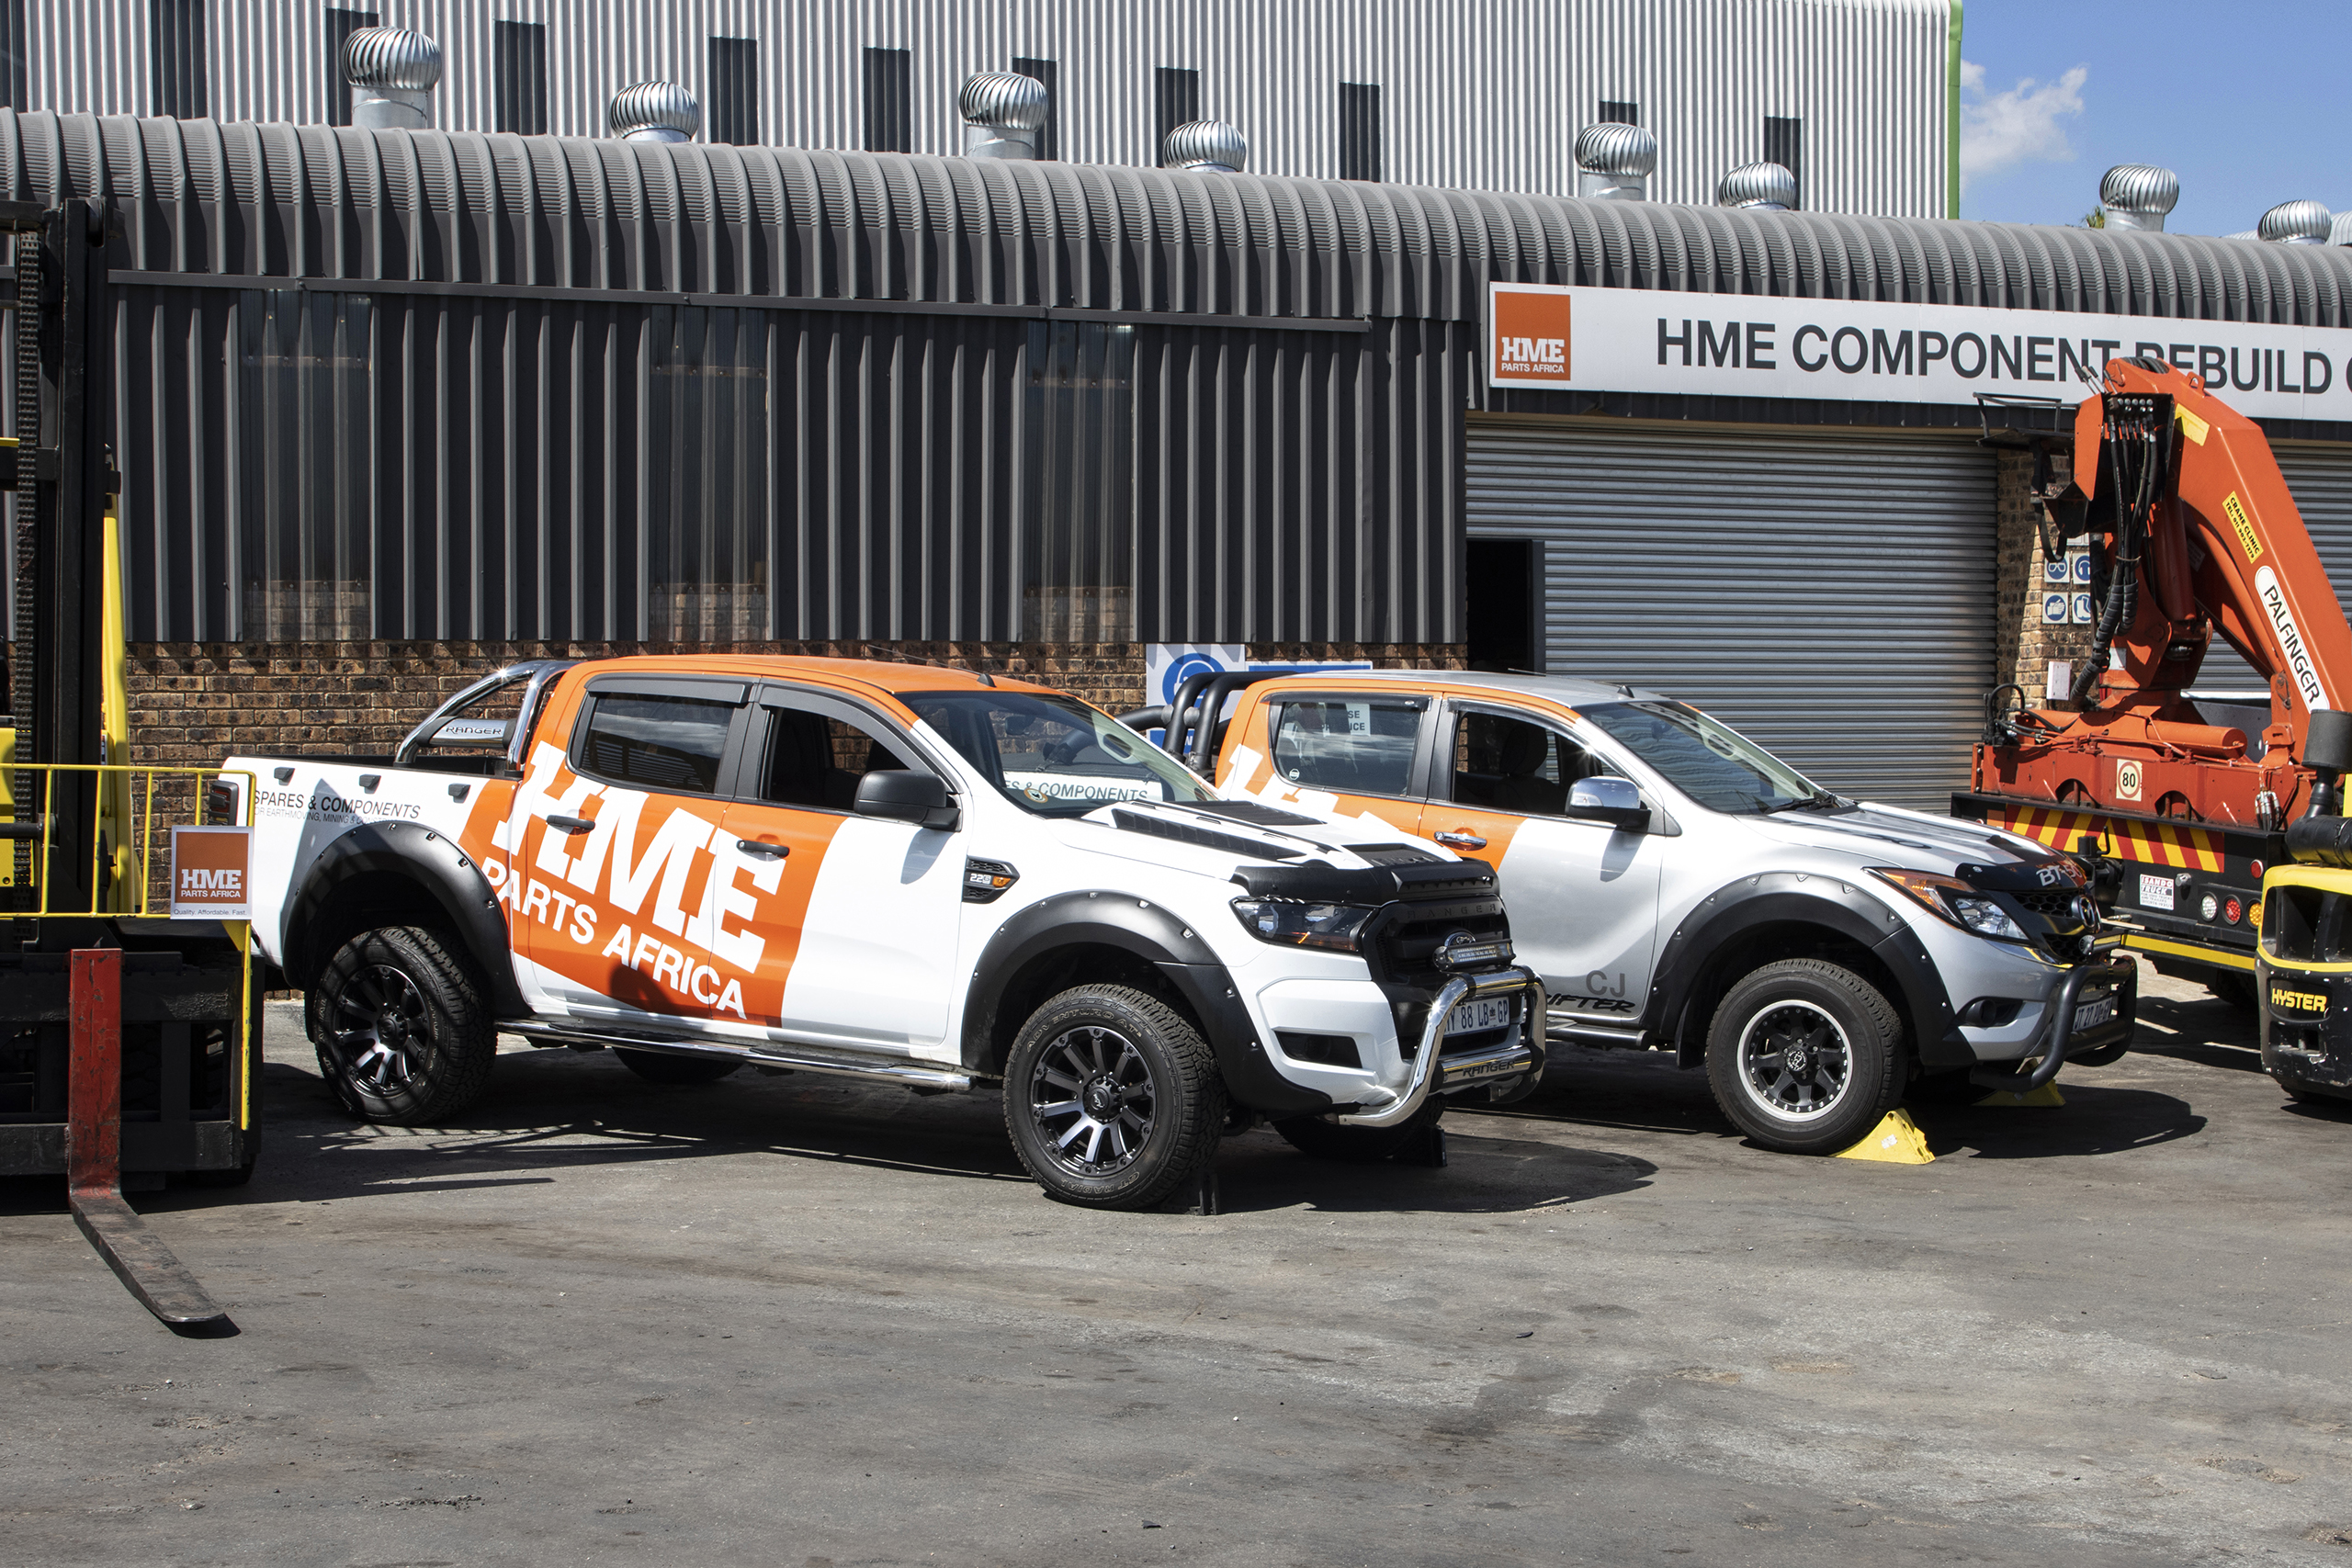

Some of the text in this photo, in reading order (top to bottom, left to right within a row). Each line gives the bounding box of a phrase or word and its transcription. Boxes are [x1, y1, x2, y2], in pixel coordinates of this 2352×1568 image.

[1501, 336, 1565, 363] HME
[1657, 318, 1776, 369] HME
[1792, 323, 2120, 385] COMPONENT
[1501, 362, 1565, 374] PARTS AFRICA
[2230, 497, 2260, 554] CRANE CLINIC
[2264, 585, 2320, 704] PALFINGER
[446, 726, 502, 735] RANGER
[2122, 772, 2136, 788] 80
[308, 795, 317, 810] &
[321, 796, 421, 819] COMPONENTS
[491, 740, 786, 974] HME
[181, 868, 242, 889] HME
[2035, 864, 2083, 886] BT-50
[2142, 875, 2173, 888] ISANDO
[180, 889, 241, 898] PARTS AFRICA
[2142, 885, 2167, 896] TRUCK
[174, 908, 196, 917] Quality.
[481, 855, 748, 1021] PARTS AFRICA
[1585, 969, 1626, 998] CJ
[1546, 993, 1635, 1012] IFTER
[2271, 987, 2327, 1012] HYSTER
[1460, 1005, 1474, 1030] 88
[1477, 1002, 1489, 1027] LB
[1498, 999, 1509, 1023] GP
[1463, 1060, 1517, 1077] RANGER
[1060, 1179, 1114, 1195] RADIAL
